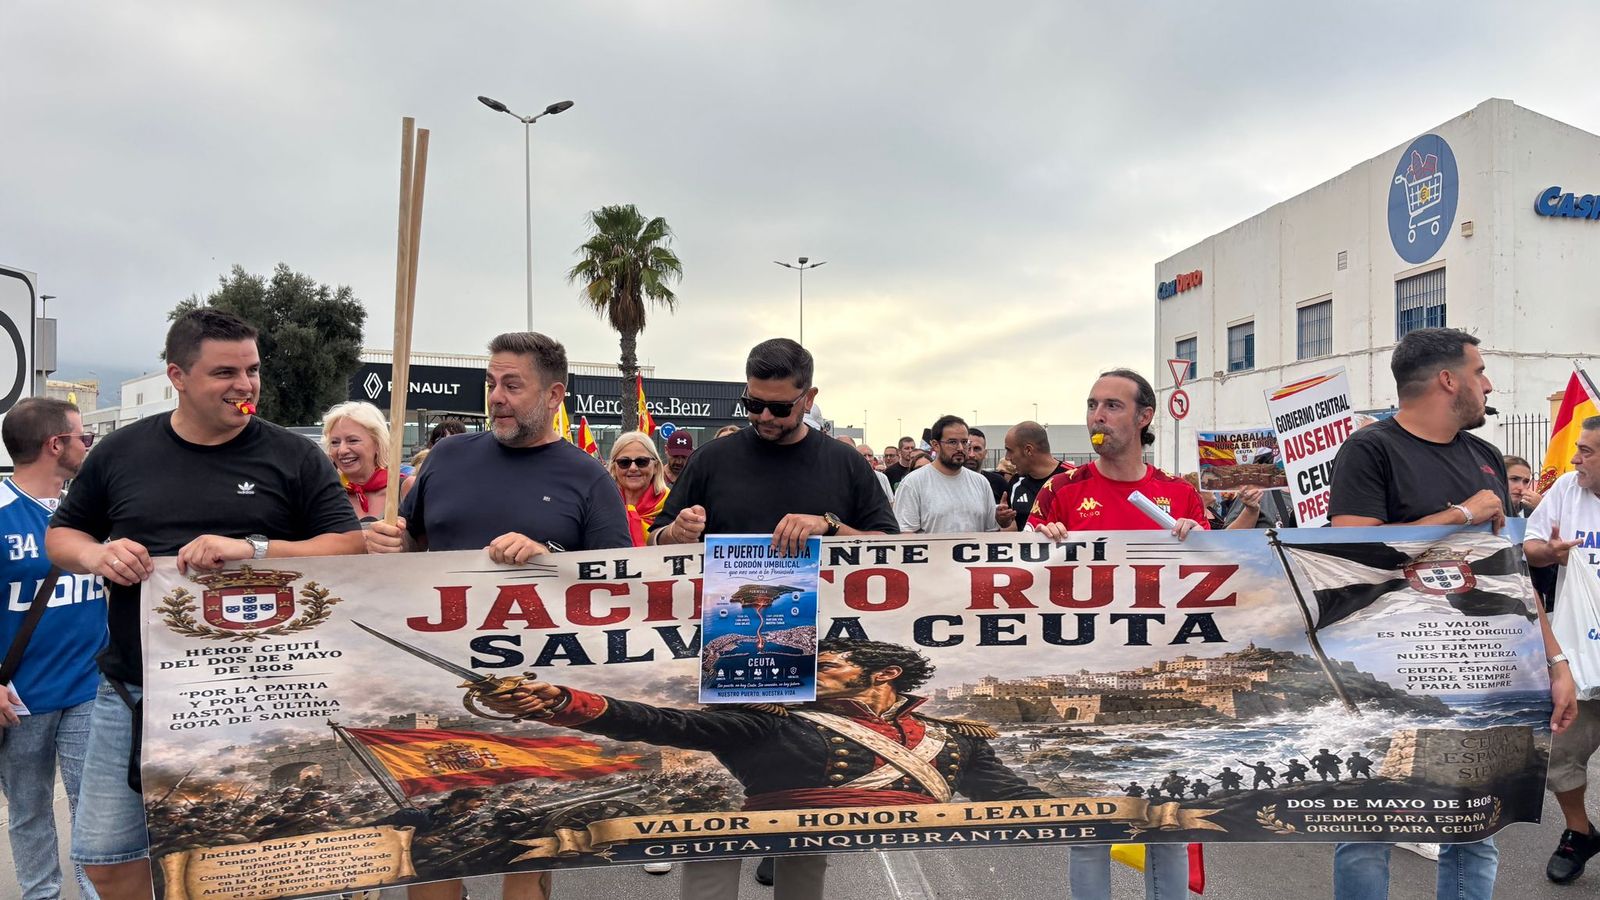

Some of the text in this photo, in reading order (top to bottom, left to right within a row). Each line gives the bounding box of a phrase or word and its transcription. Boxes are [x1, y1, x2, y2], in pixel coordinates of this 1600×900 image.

[387, 380, 461, 395] RNAULT
[575, 394, 711, 417] Merces-Benz
[1275, 393, 1351, 434] GOBIERNO CENTRAL
[1214, 434, 1230, 443] UN
[1241, 441, 1251, 449] SE
[1297, 490, 1331, 524] PRES
[577, 558, 642, 581] EL
[951, 537, 1108, 564] CEUTÍ
[713, 545, 725, 559] EL
[727, 545, 765, 559] PUERTO
[724, 559, 800, 569] EL CORDÓN UMBILICAL
[406, 563, 1241, 633] JACIO RUIZ
[1418, 620, 1490, 629] SU VALOR
[469, 625, 702, 669] SALV
[912, 612, 1230, 649] CEUTA
[1377, 628, 1523, 639] ES NUESTRO ORGULLO
[185, 640, 320, 658] HÉROE CEUTÍ
[1396, 650, 1518, 660] NUESTRA FUERZA
[159, 650, 343, 670] DEL DOS DE MAYO
[748, 657, 776, 667] CEUTA
[213, 663, 294, 675] DE 1808
[1459, 664, 1518, 673] ESPAÑOLA
[1407, 672, 1512, 682] DESDE SIEMPRE
[1466, 680, 1513, 689] SIEMPRE
[234, 686, 258, 695] LA
[265, 682, 329, 692] PATRIA
[172, 699, 341, 720] HASTA LA ÚLTIMA
[189, 701, 202, 709] Y
[209, 697, 246, 706] POR
[169, 719, 221, 731] GOTA
[228, 715, 253, 725] DE
[1287, 795, 1493, 809] DOS DE MAYO DE 1808
[633, 801, 1119, 835] VALOR HONOR LEALTAD
[1304, 812, 1486, 823] EJEMPLO PARA ESPAÑA
[1306, 824, 1485, 834] ORGULLO PARA CEUTA
[199, 831, 383, 861] Jacinto Ruiz y Mendoza
[644, 826, 1098, 856] CEUTA, INQUEBRANTABLE
[217, 854, 271, 867] Teniente
[275, 850, 291, 859] del
[294, 843, 360, 857] Regimiento
[240, 850, 352, 870] Infantería de Ceuta
[199, 869, 258, 882] Combatió
[260, 864, 292, 876] junto
[304, 859, 338, 868] Daoiz
[340, 857, 348, 865] y
[350, 852, 392, 861] Velarde
[249, 871, 295, 883] defensa
[297, 868, 316, 877] del
[319, 863, 357, 874] Parque
[202, 865, 391, 895] Artillería de Monteleón (Madrid)
[232, 891, 244, 899] el
[258, 887, 273, 895] de
[276, 883, 313, 894] mayo
[329, 876, 358, 886] 1808
